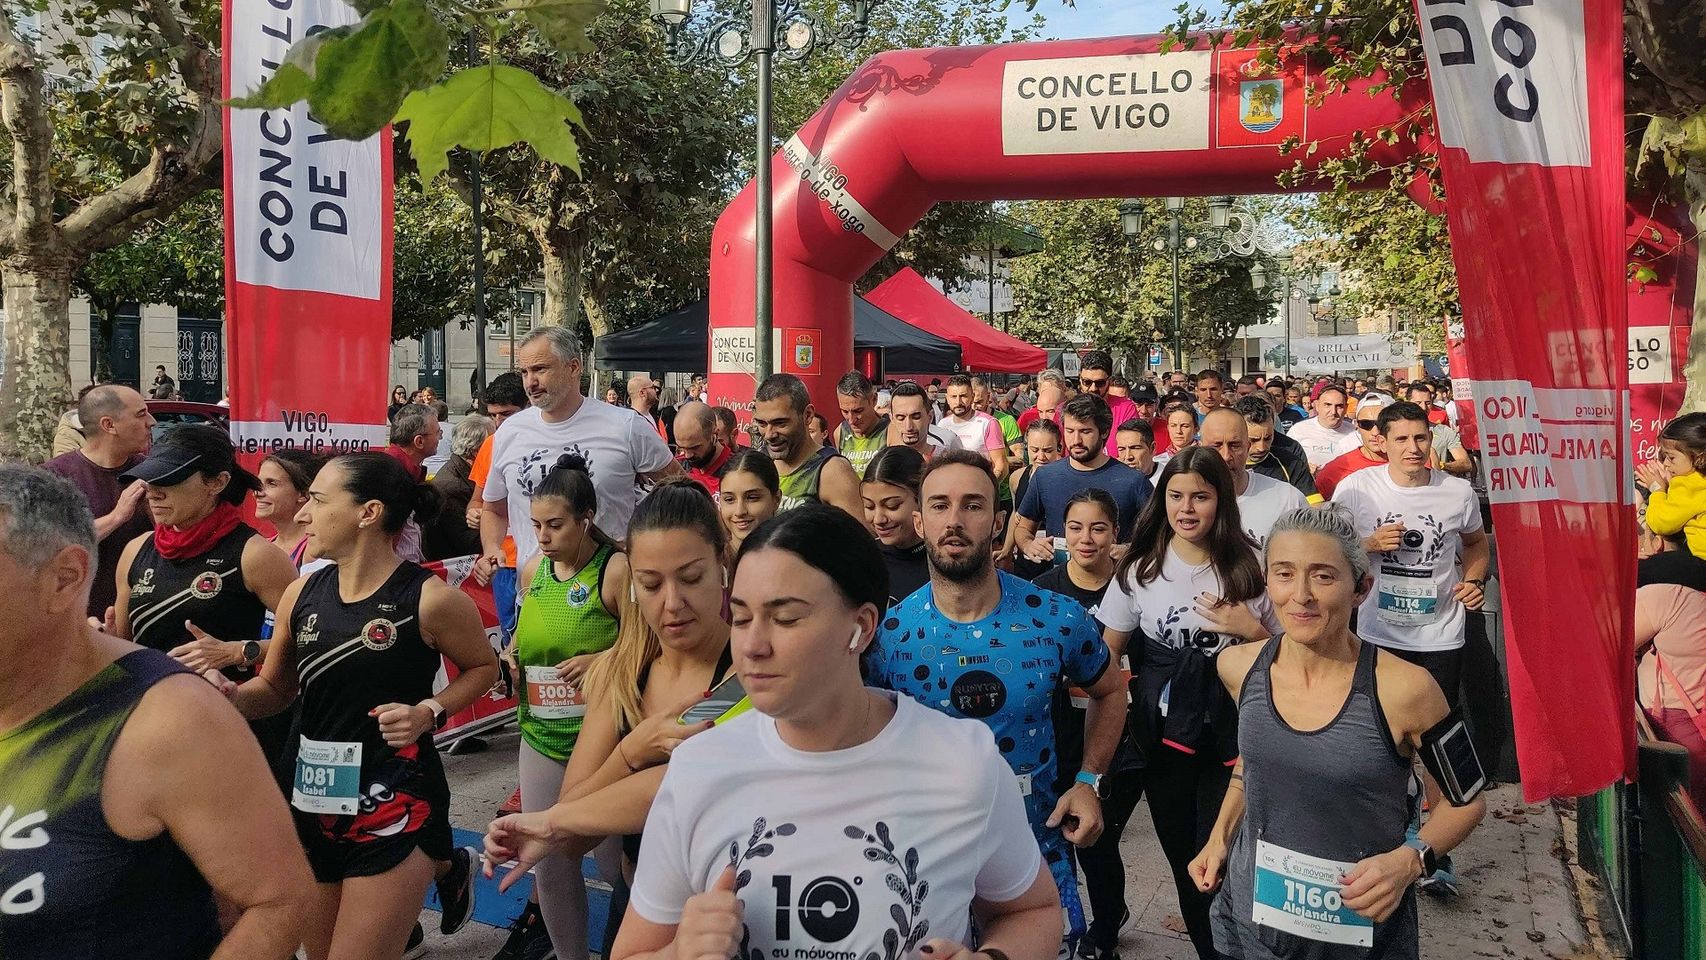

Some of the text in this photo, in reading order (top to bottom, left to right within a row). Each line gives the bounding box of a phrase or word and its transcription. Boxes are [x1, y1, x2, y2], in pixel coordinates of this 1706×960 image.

[1018, 69, 1192, 99] CONCELLO
[1037, 103, 1170, 132] DE VIGO
[308, 165, 348, 235] DE
[811, 179, 830, 200] de
[831, 200, 865, 233] xogo
[718, 352, 754, 362] DE VIG
[1318, 343, 1361, 353] BRILAT
[282, 411, 333, 436] VIGO,
[303, 434, 324, 454] de
[1387, 605, 1408, 615] Miguel
[1393, 597, 1420, 609] 1114
[538, 685, 576, 699] 5003
[302, 765, 335, 787] 1081
[303, 784, 327, 797] Isabel
[1284, 879, 1342, 912] 1160
[1282, 902, 1341, 924] Alejandra
